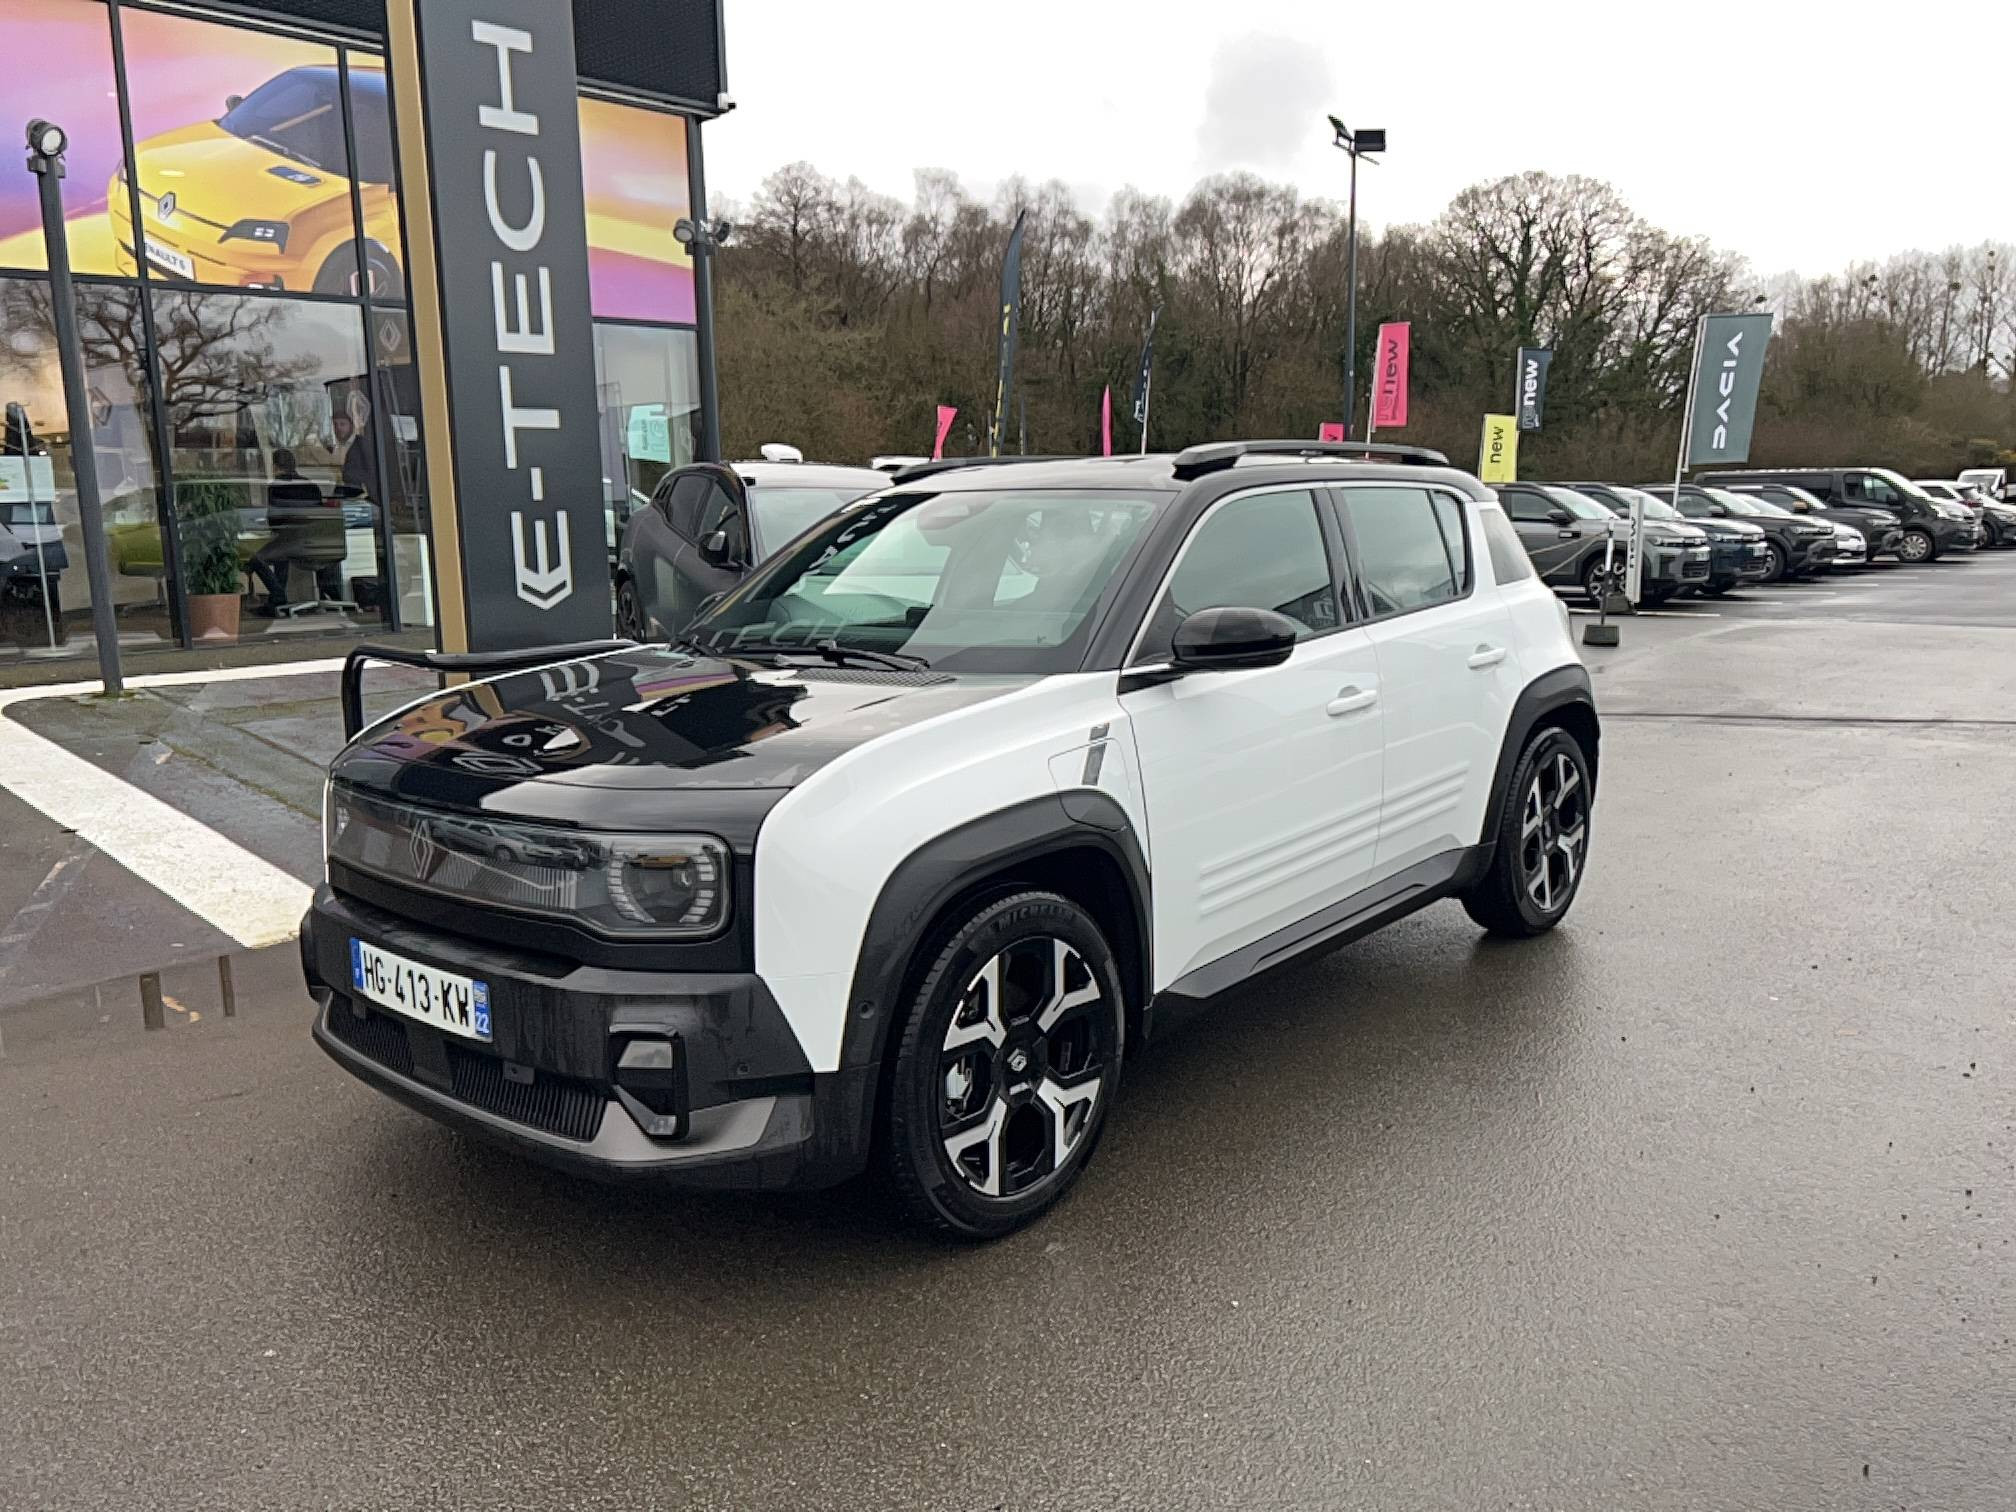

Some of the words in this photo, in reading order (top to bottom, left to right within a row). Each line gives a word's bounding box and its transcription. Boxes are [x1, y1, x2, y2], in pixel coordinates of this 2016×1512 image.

[471, 18, 574, 611] E-TECH
[1712, 330, 1744, 449] DACIA
[363, 949, 471, 1028] HG-413-KW
